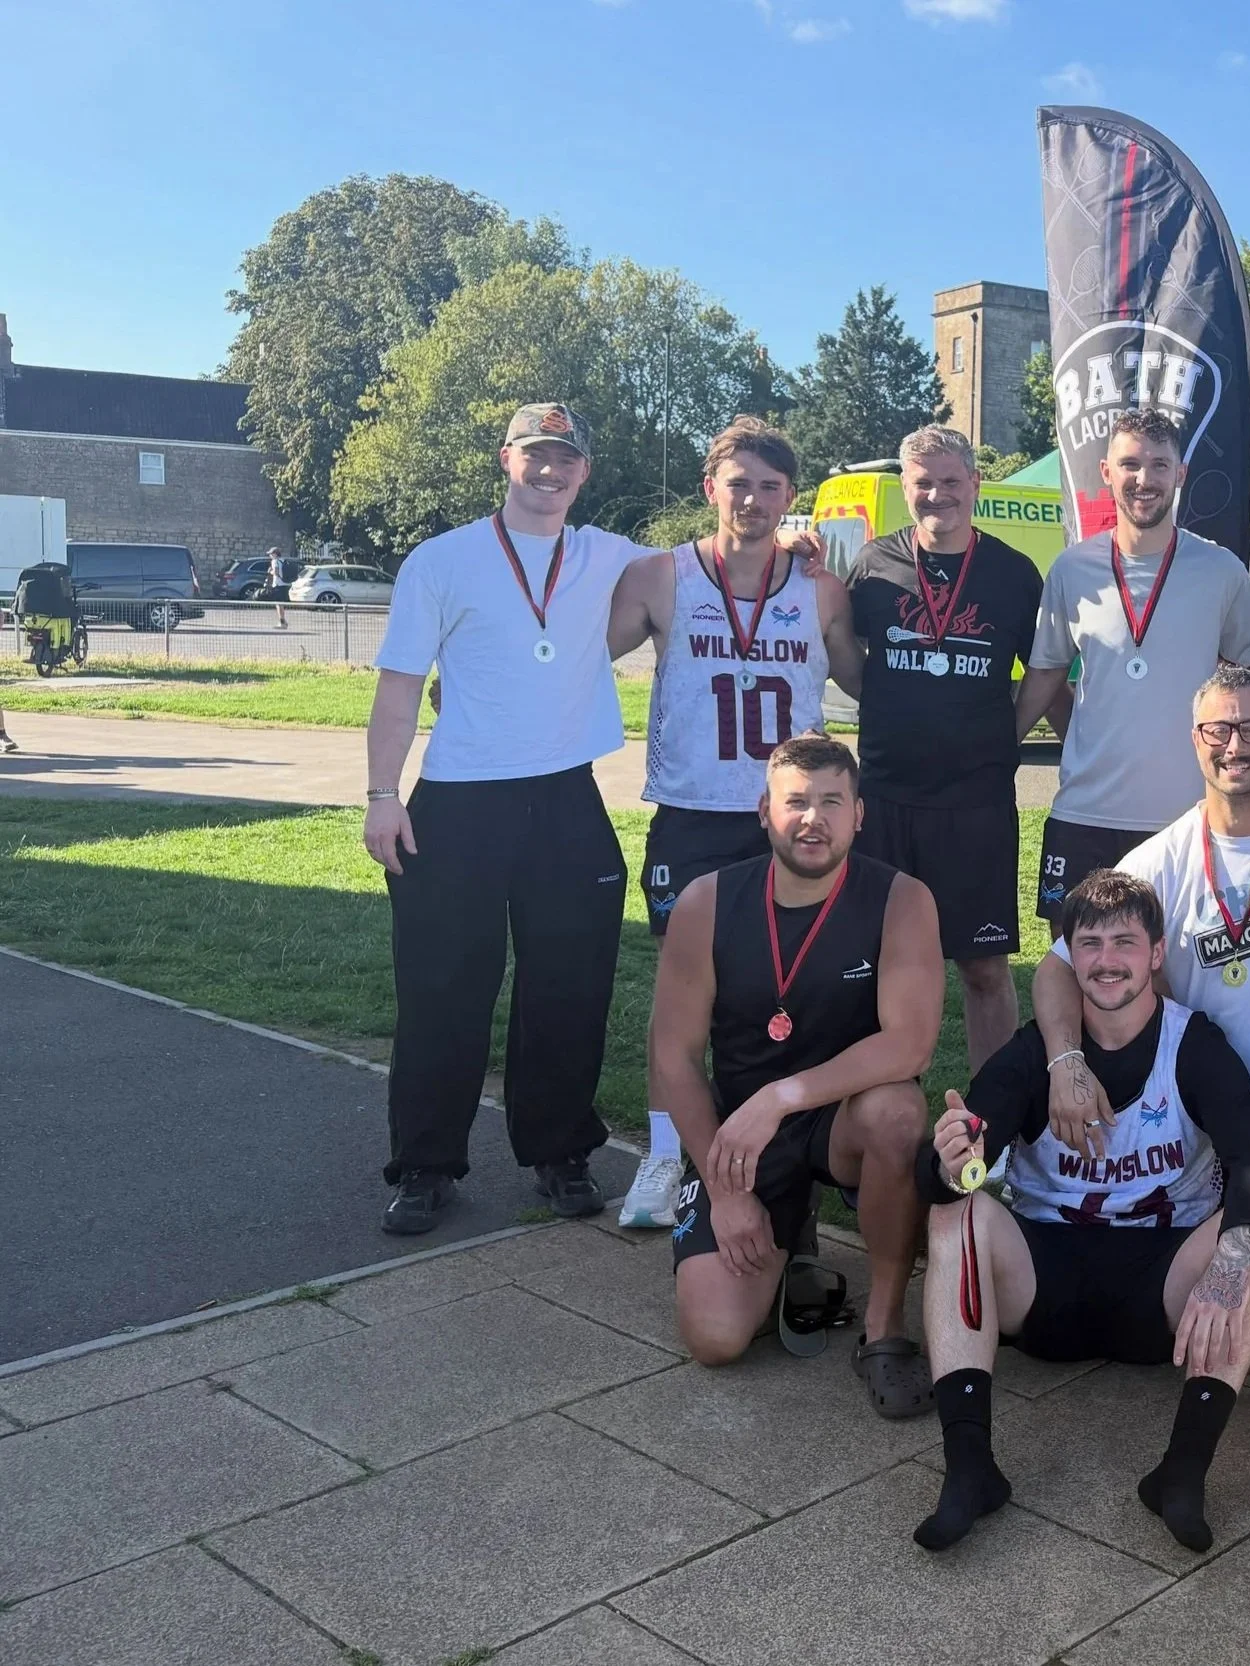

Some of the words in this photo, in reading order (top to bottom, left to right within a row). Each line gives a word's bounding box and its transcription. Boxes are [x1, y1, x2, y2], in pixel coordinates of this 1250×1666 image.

[1055, 351, 1205, 429] BATH
[692, 614, 725, 622] PIONEER
[954, 654, 992, 677] BOX
[711, 673, 792, 760] 10
[651, 864, 670, 886] 10
[1045, 854, 1066, 877] 33
[973, 934, 1009, 943] PIONEER
[1058, 1139, 1185, 1185] WILMSLOW
[678, 1179, 701, 1210] 20
